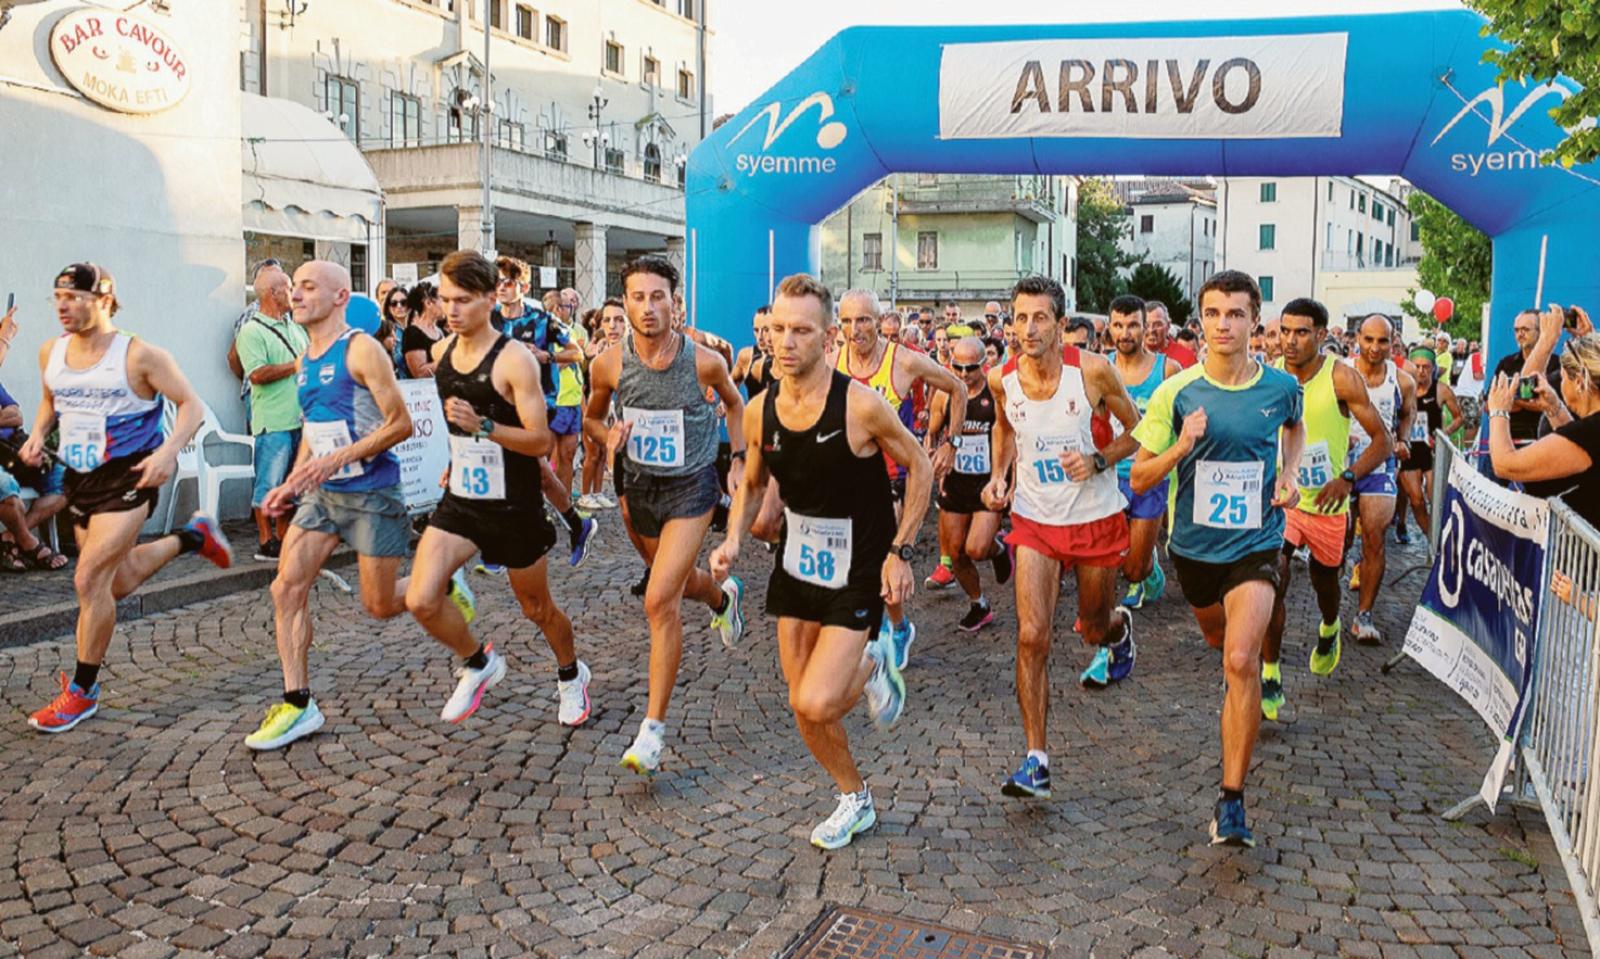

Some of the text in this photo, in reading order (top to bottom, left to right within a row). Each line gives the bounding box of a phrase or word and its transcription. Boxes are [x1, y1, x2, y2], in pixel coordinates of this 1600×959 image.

[59, 17, 187, 80] BAR CAVOUR
[82, 72, 169, 105] MOKA EFTI
[1010, 56, 1263, 115] ARRIVO
[736, 153, 837, 177] syemme
[1450, 148, 1575, 177] syem
[64, 444, 100, 469] 156
[633, 435, 676, 463] 125
[956, 453, 985, 472] 126
[462, 467, 490, 496] 43
[1033, 457, 1073, 484] 15
[1208, 492, 1248, 525] 25
[799, 543, 836, 581] 58
